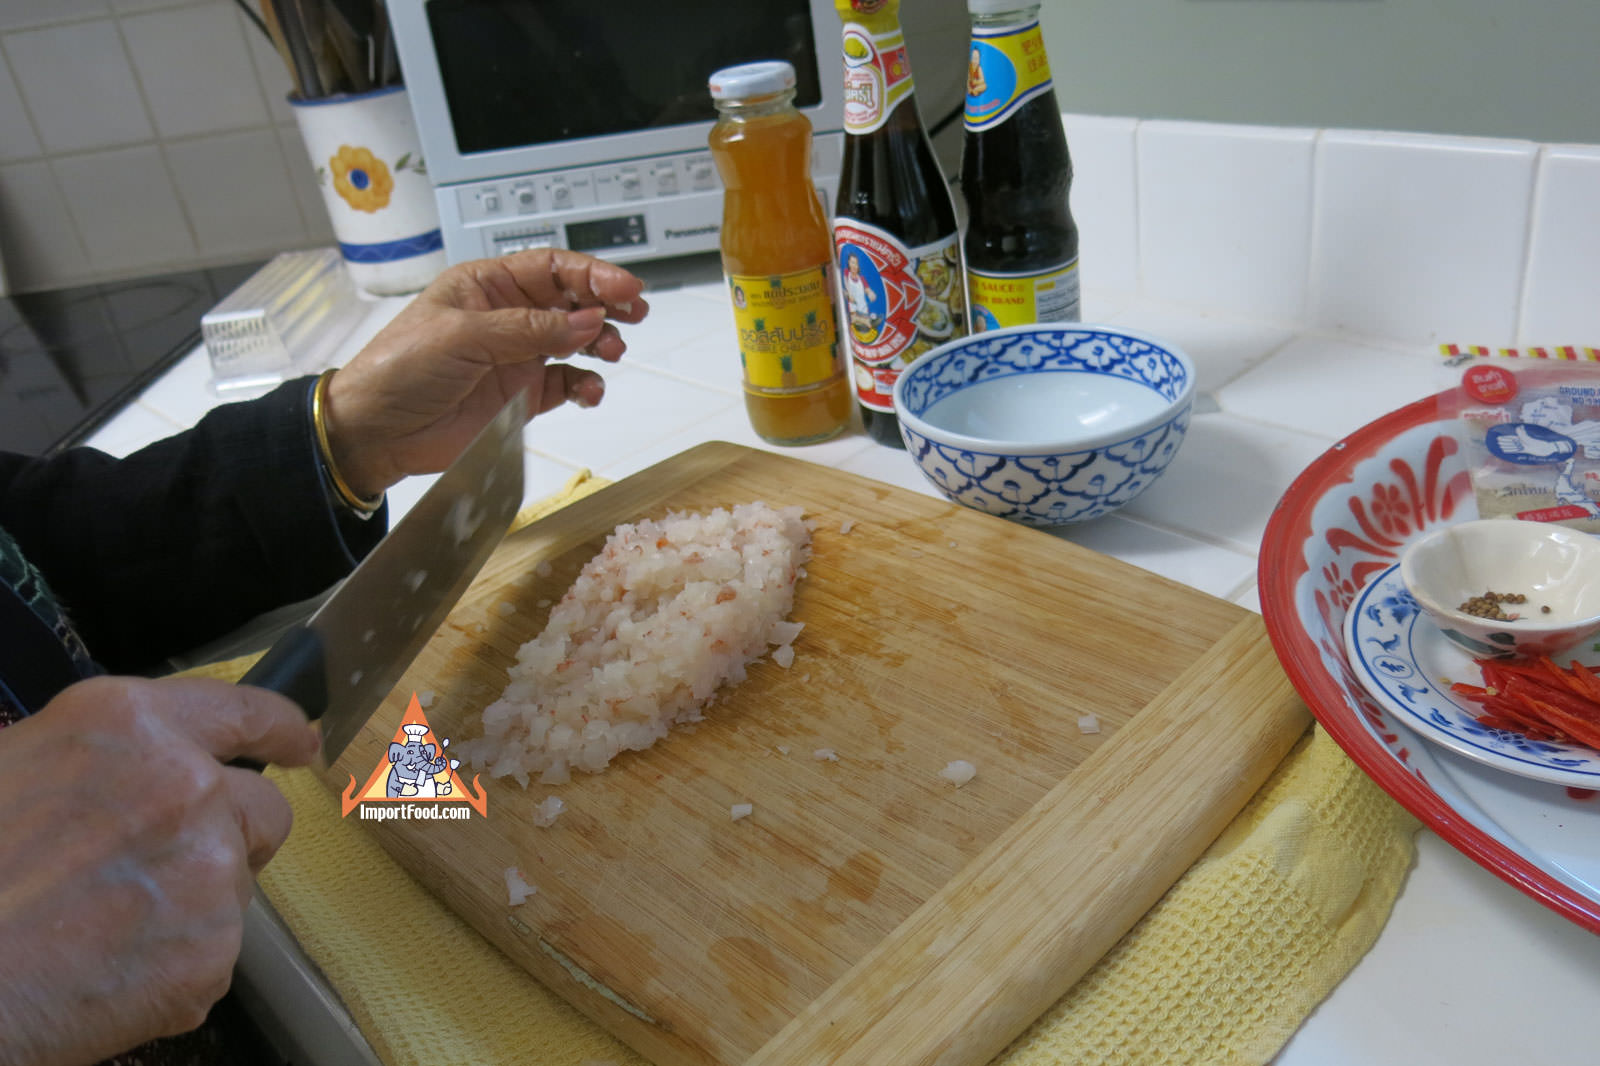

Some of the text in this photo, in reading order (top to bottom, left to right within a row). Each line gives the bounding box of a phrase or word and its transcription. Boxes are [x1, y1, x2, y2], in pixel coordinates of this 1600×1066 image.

[664, 225, 720, 241] Panasonic
[991, 297, 1025, 305] BRAND
[1559, 386, 1596, 396] GROUND
